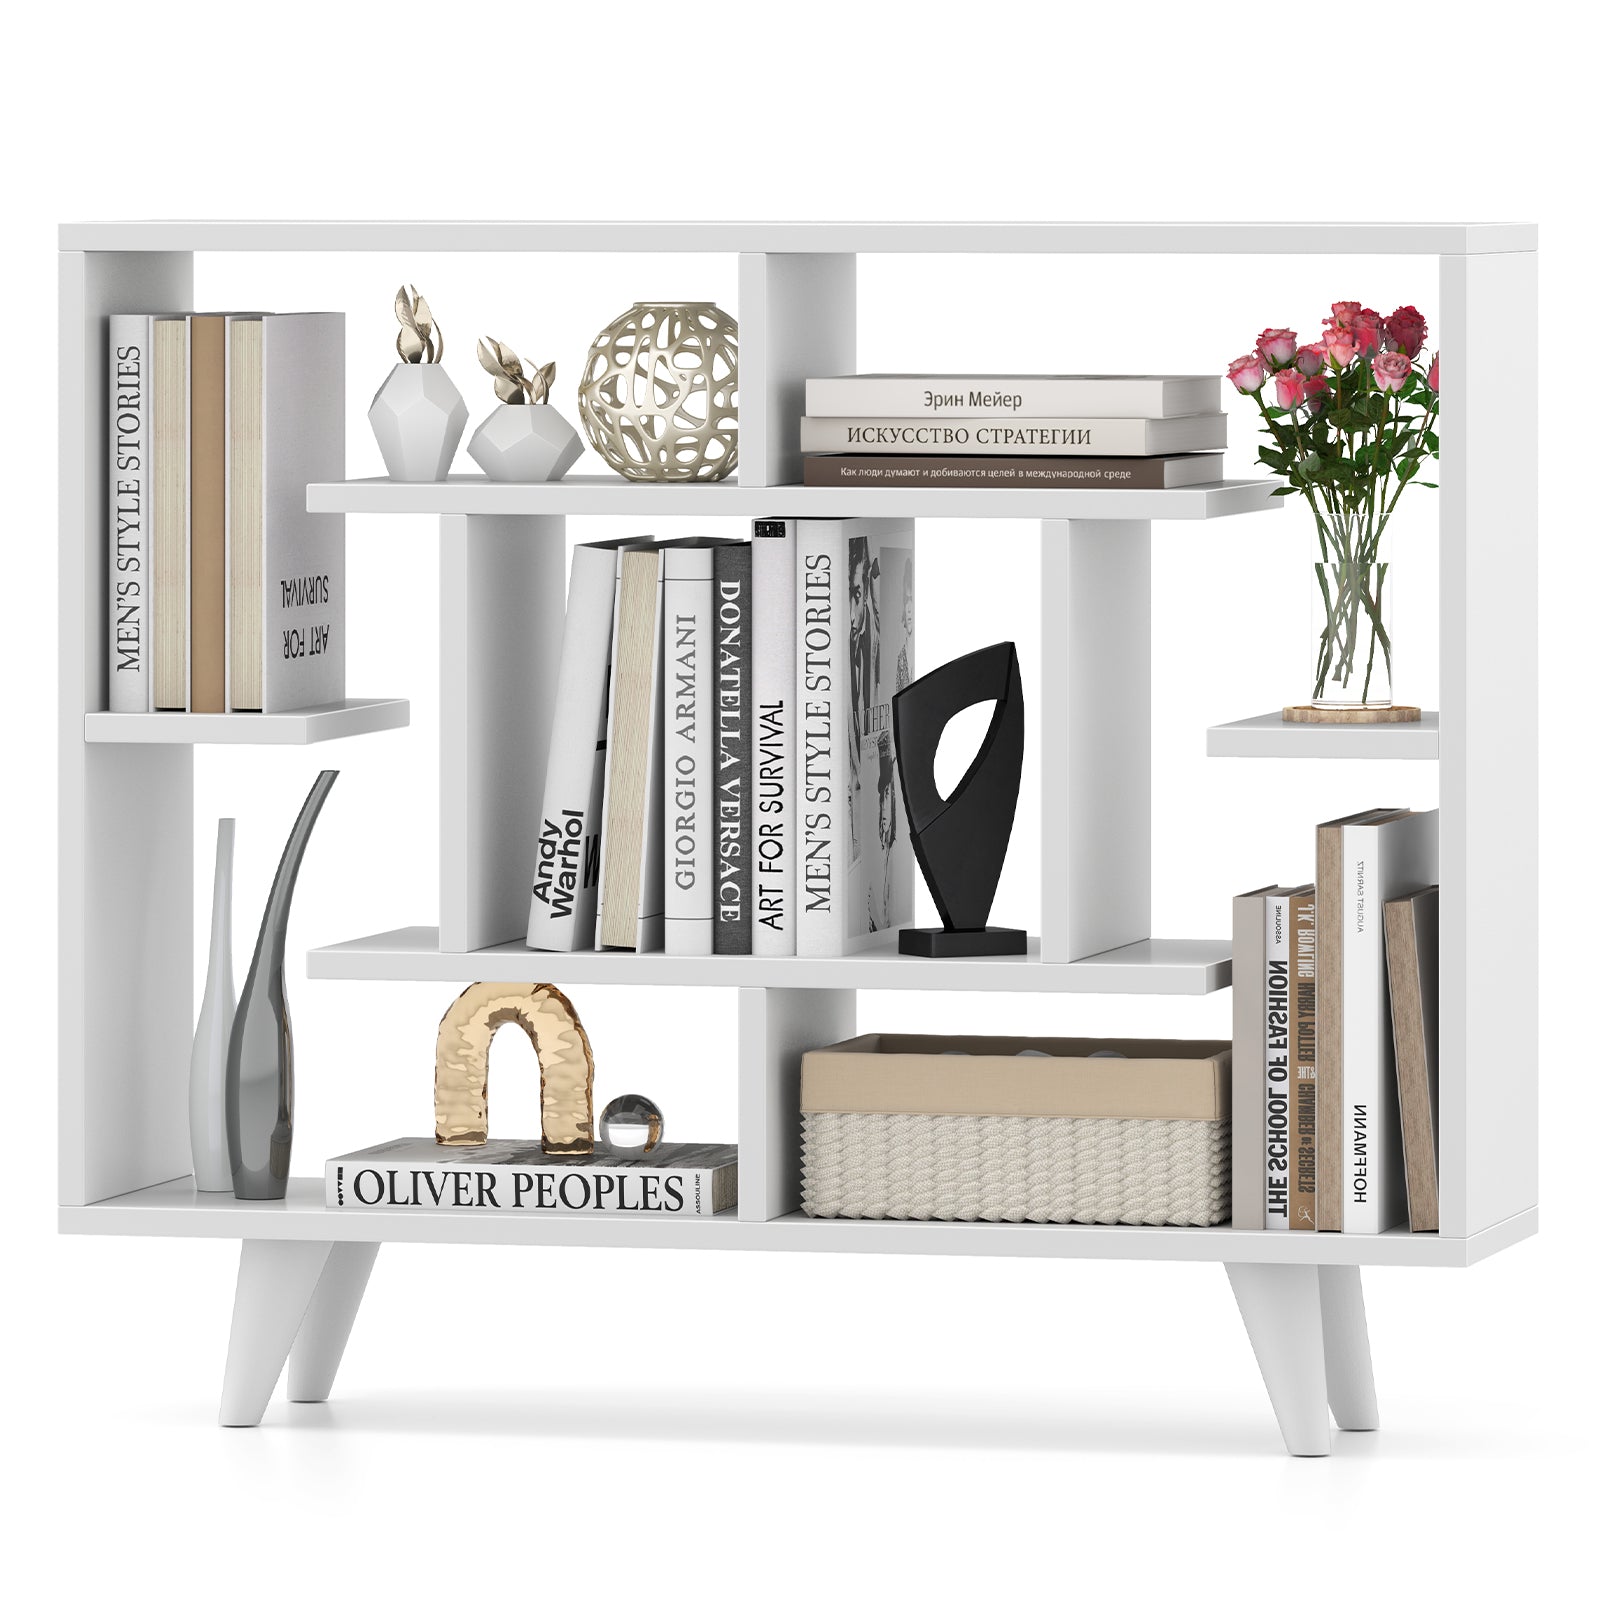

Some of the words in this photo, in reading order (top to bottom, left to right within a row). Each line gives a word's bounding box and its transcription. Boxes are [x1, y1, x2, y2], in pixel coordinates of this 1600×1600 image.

[116, 346, 141, 471] STORIES
[847, 427, 970, 444] ИСКУССТВО
[976, 428, 1092, 445] СТРАТЕГИИ
[924, 390, 964, 411] Эрин
[968, 390, 1022, 412] Мейер
[840, 467, 857, 476] Как
[858, 468, 884, 478] люди
[884, 470, 920, 478] думают
[930, 468, 986, 478] добиваются
[988, 468, 1016, 478] целей
[1026, 468, 1102, 480] международной
[1104, 471, 1132, 480] среде
[116, 479, 141, 572] STYLE
[280, 575, 328, 608] SURVIVAL
[805, 554, 832, 692] STORIES
[283, 628, 304, 659] FOR
[309, 624, 330, 656] ART
[676, 614, 696, 744] ARMANI
[720, 579, 741, 770] DONATELLA
[758, 700, 784, 814] SURVIVAL
[805, 701, 832, 803] STYLE
[532, 818, 562, 904] Andy
[550, 810, 584, 919] Warhol
[675, 755, 696, 890] GIORGIO
[720, 776, 741, 922] VERSACE
[758, 823, 784, 872] FOR
[758, 884, 784, 930] ART
[353, 1169, 502, 1208] OLIVER
[511, 1173, 684, 1212] PEOPLES
